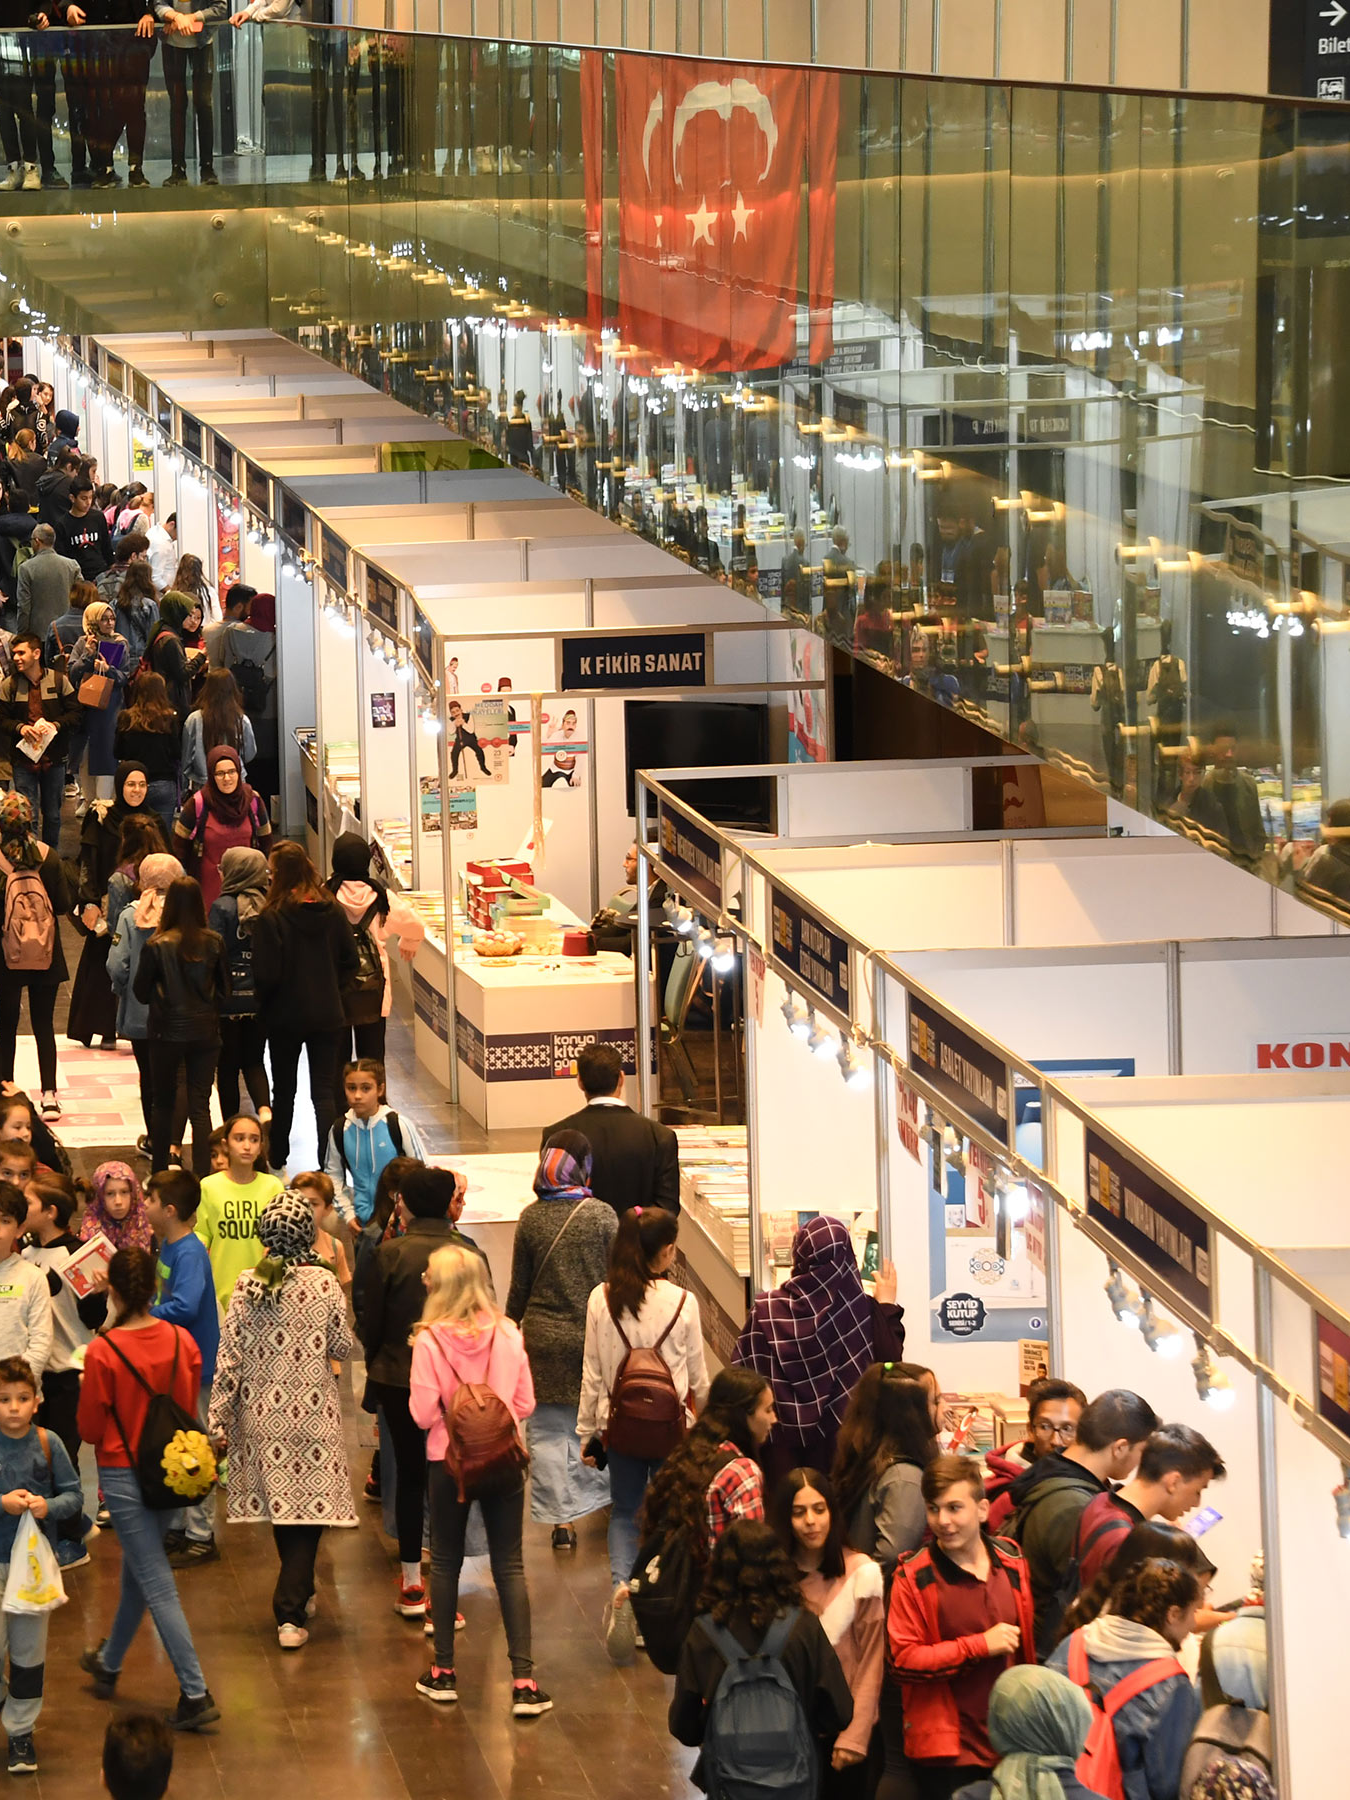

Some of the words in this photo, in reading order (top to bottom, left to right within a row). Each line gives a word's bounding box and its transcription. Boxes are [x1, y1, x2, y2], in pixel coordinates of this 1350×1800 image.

[580, 656, 592, 675] K
[595, 652, 641, 675] FİKİR
[645, 652, 702, 673] SANAT
[554, 1034, 595, 1046] konya
[224, 1200, 261, 1220] GIRL
[218, 1220, 260, 1241] SQUA
[946, 1299, 979, 1310] SEYYİD
[947, 1309, 978, 1319] KUTUP
